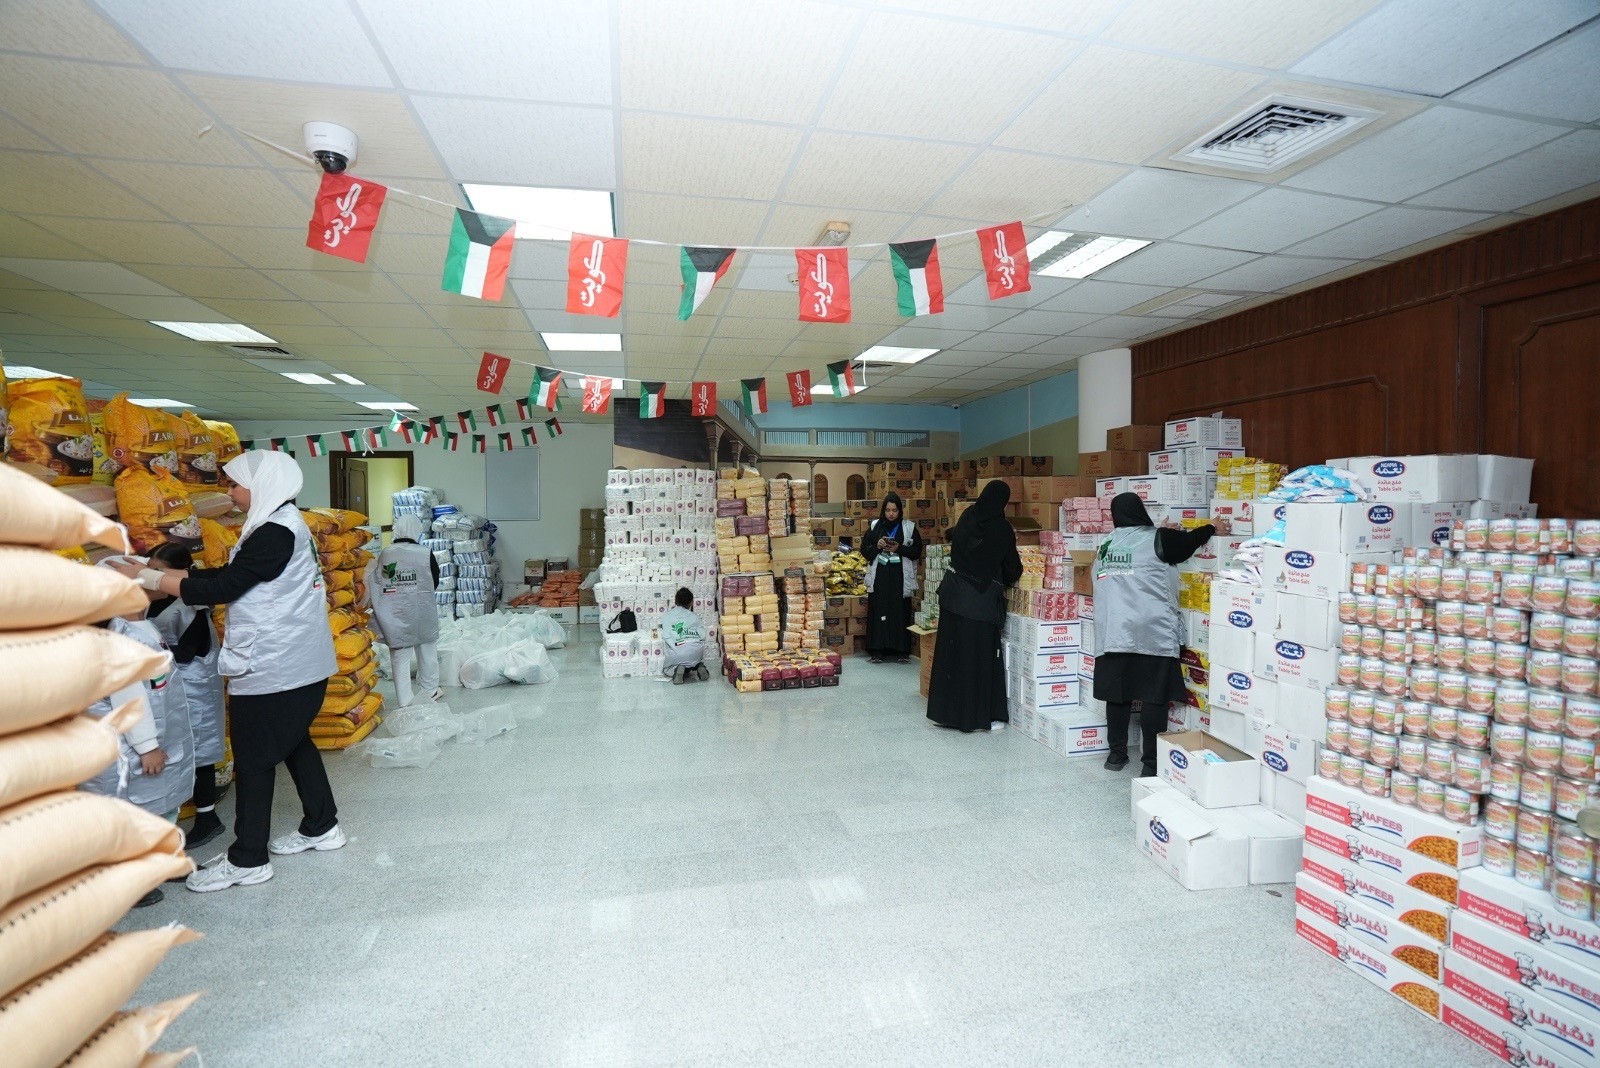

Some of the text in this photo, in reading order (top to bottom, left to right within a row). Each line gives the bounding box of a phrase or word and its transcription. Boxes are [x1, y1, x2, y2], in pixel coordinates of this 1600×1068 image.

[810, 253, 834, 318] كويت
[1047, 635, 1073, 643] Gelatin
[1076, 738, 1103, 747] Gelatin
[1362, 810, 1403, 832] NAFEES
[1361, 844, 1402, 868] NAFEES
[1355, 878, 1394, 904] NAFEES
[1349, 912, 1388, 936] نفيس
[1548, 922, 1600, 951] فيس
[1348, 945, 1387, 974] NAFEES
[1530, 1008, 1595, 1047] نفيس
